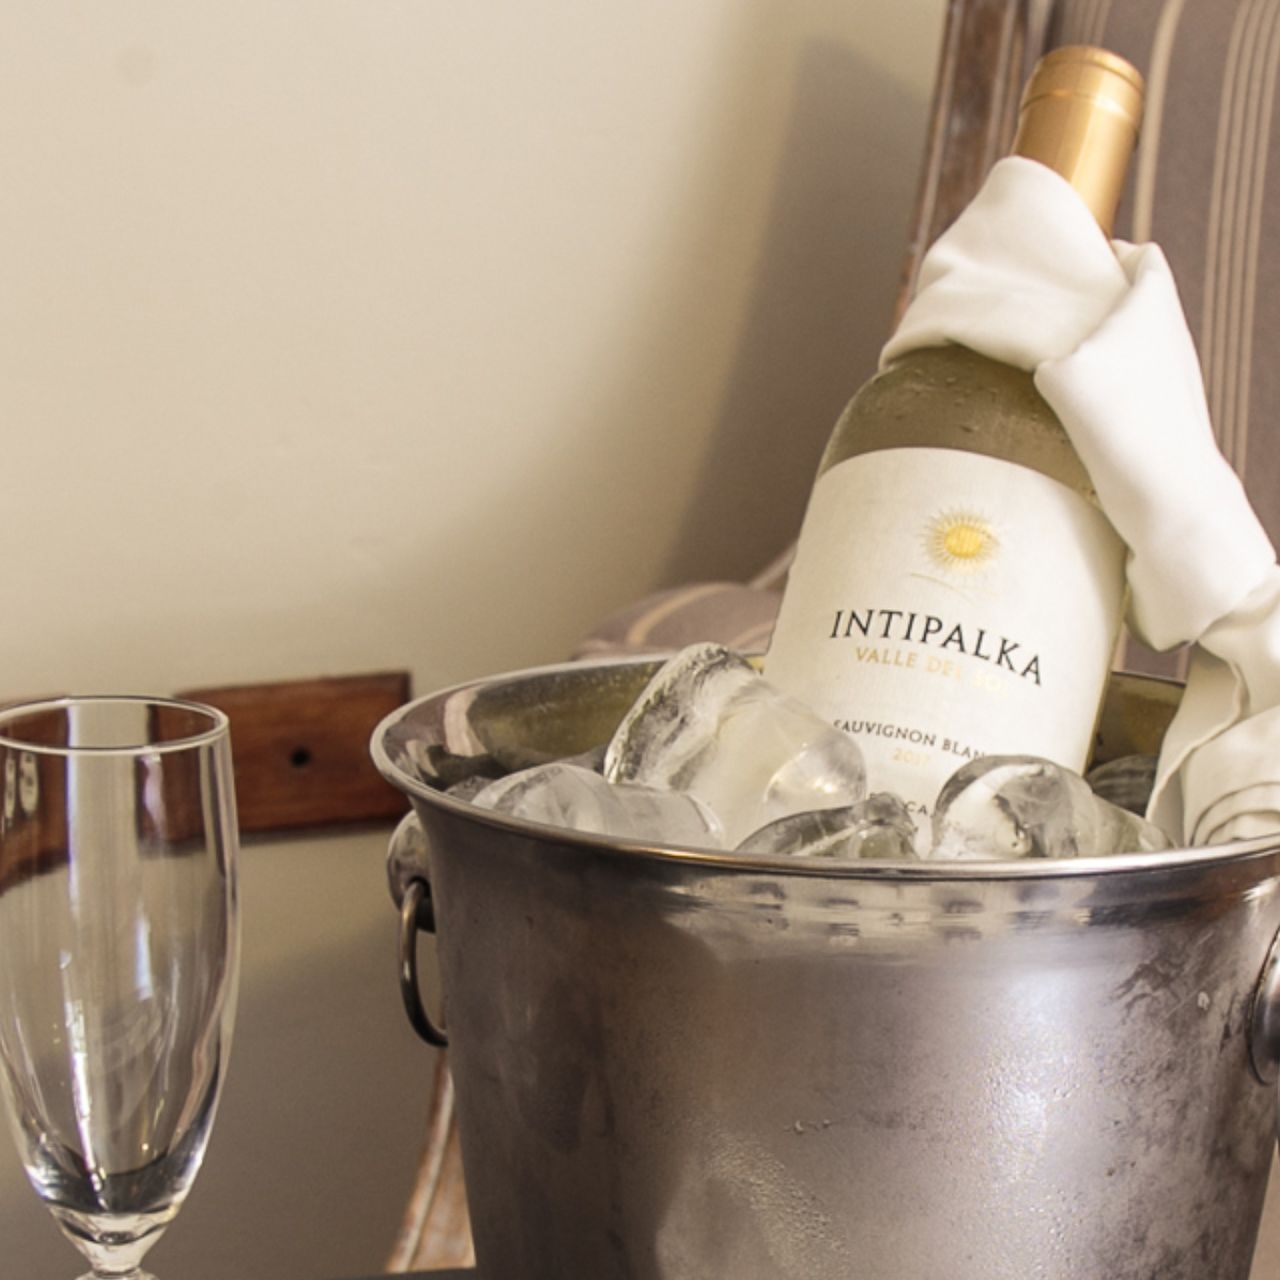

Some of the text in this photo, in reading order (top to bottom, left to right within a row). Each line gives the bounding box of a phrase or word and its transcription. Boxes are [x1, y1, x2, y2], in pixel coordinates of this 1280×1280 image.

[829, 609, 1042, 686] INTIPALKA
[856, 647, 918, 668] VALLE
[942, 738, 986, 762] BLAN
